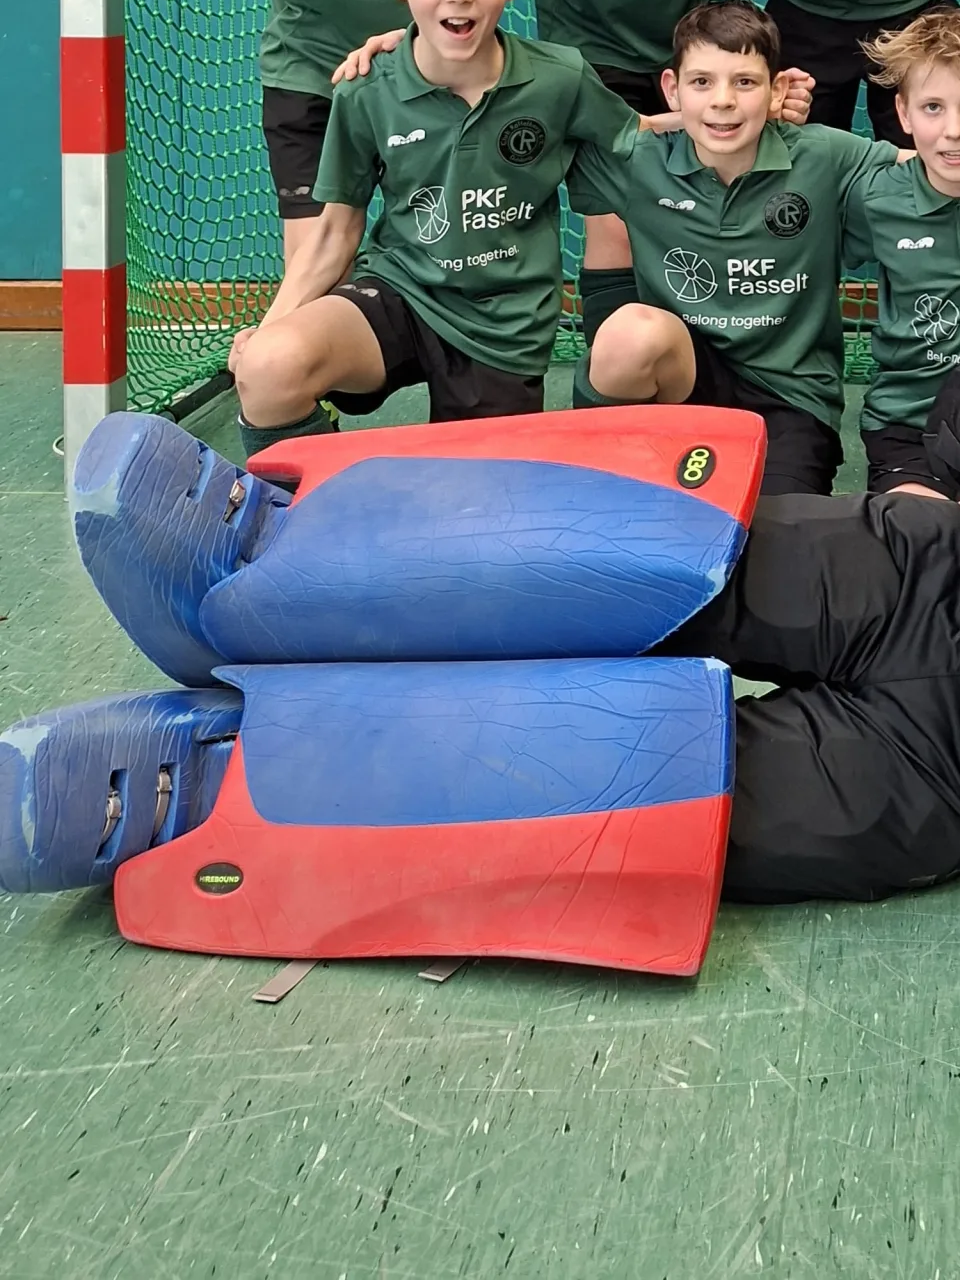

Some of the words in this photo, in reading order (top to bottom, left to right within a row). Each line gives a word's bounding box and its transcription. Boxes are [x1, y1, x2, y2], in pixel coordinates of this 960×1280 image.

[461, 186, 507, 211] PKF
[462, 201, 534, 233] Fasselt
[727, 258, 776, 277] PKF
[728, 273, 809, 296] Fasselt
[682, 313, 728, 329] Belong
